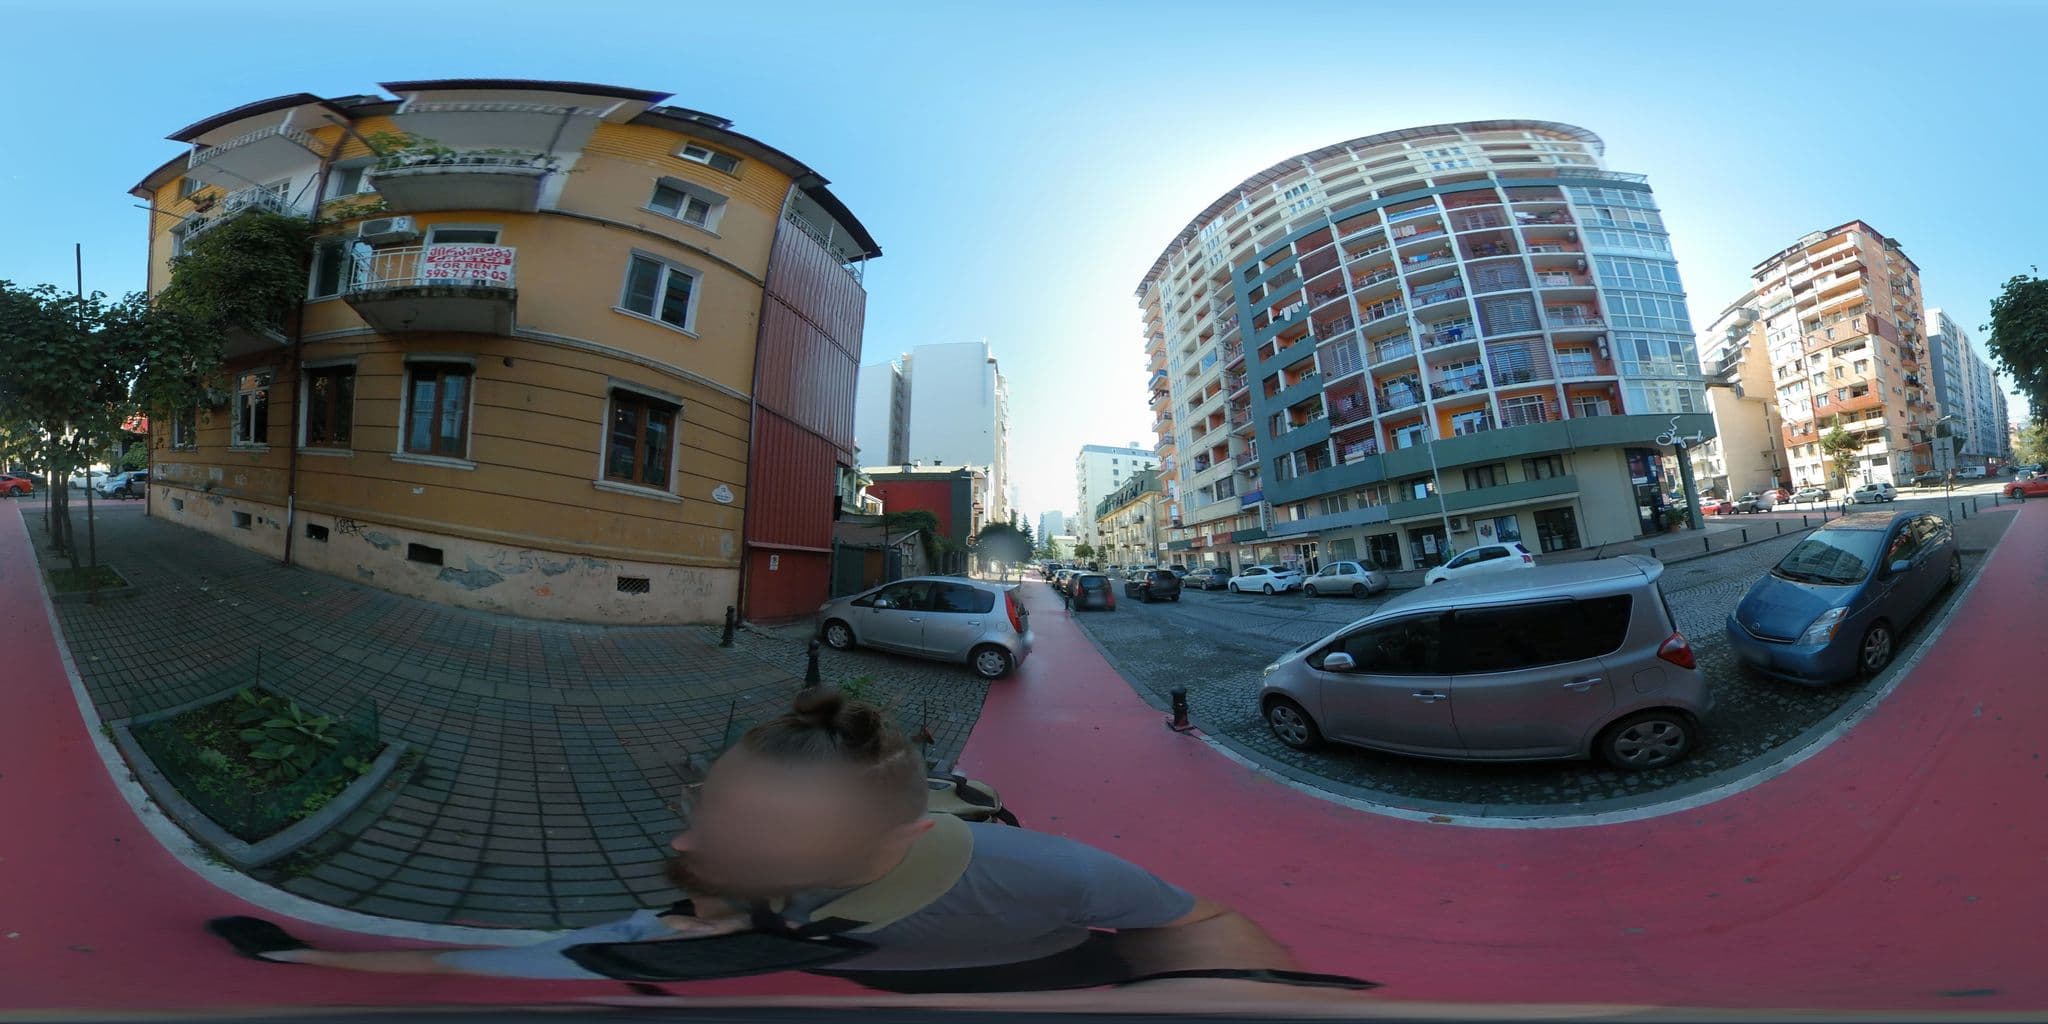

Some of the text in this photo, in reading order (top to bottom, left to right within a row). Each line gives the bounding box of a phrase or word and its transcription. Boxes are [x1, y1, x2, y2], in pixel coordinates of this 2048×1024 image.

[426, 269, 507, 280] 596 77 03 03
